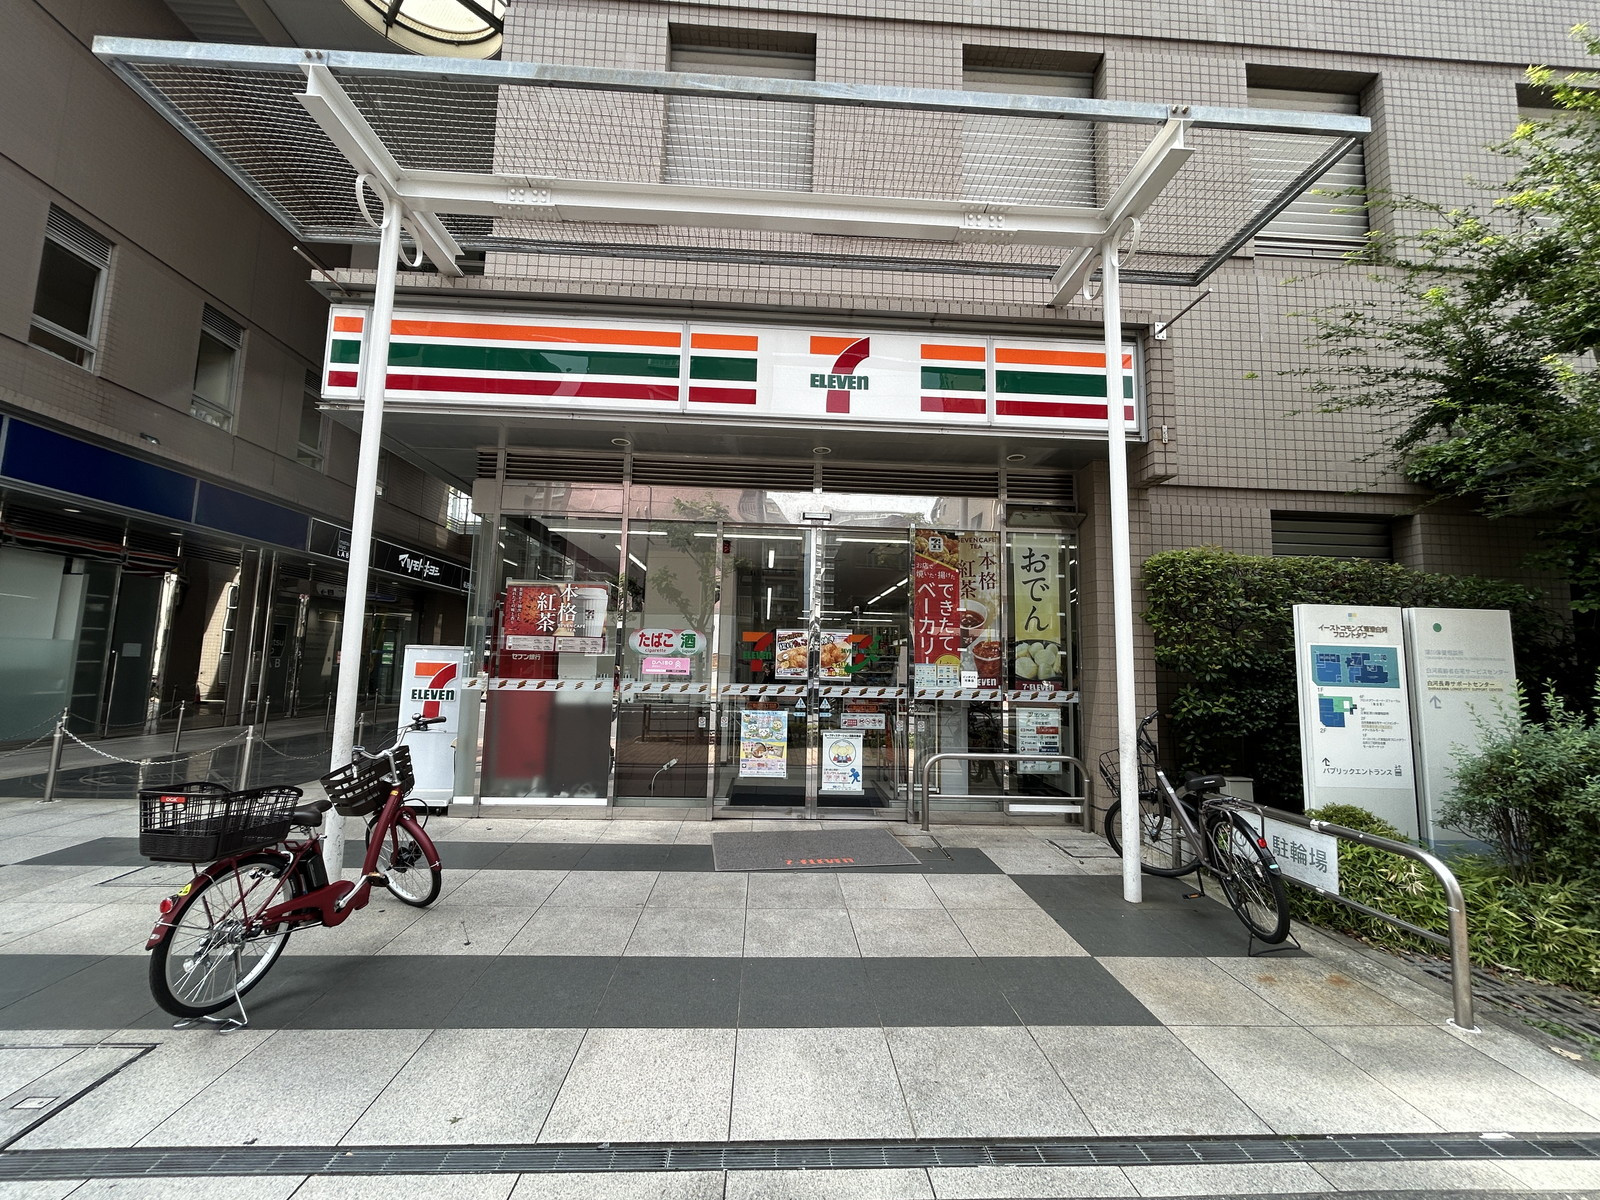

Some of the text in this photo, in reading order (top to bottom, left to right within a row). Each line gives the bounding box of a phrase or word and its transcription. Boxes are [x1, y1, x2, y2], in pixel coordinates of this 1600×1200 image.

[958, 560, 977, 599] 紅茶
[978, 551, 997, 591] 本格
[1020, 547, 1050, 632] おでん
[535, 592, 557, 632] 紅茶
[558, 583, 578, 622] 本格
[938, 583, 954, 651] できたて
[638, 632, 674, 648] たばこ
[680, 633, 696, 649] 酒
[1323, 767, 1393, 776] パブリックエントランス
[1272, 835, 1328, 873] 駐輪場
